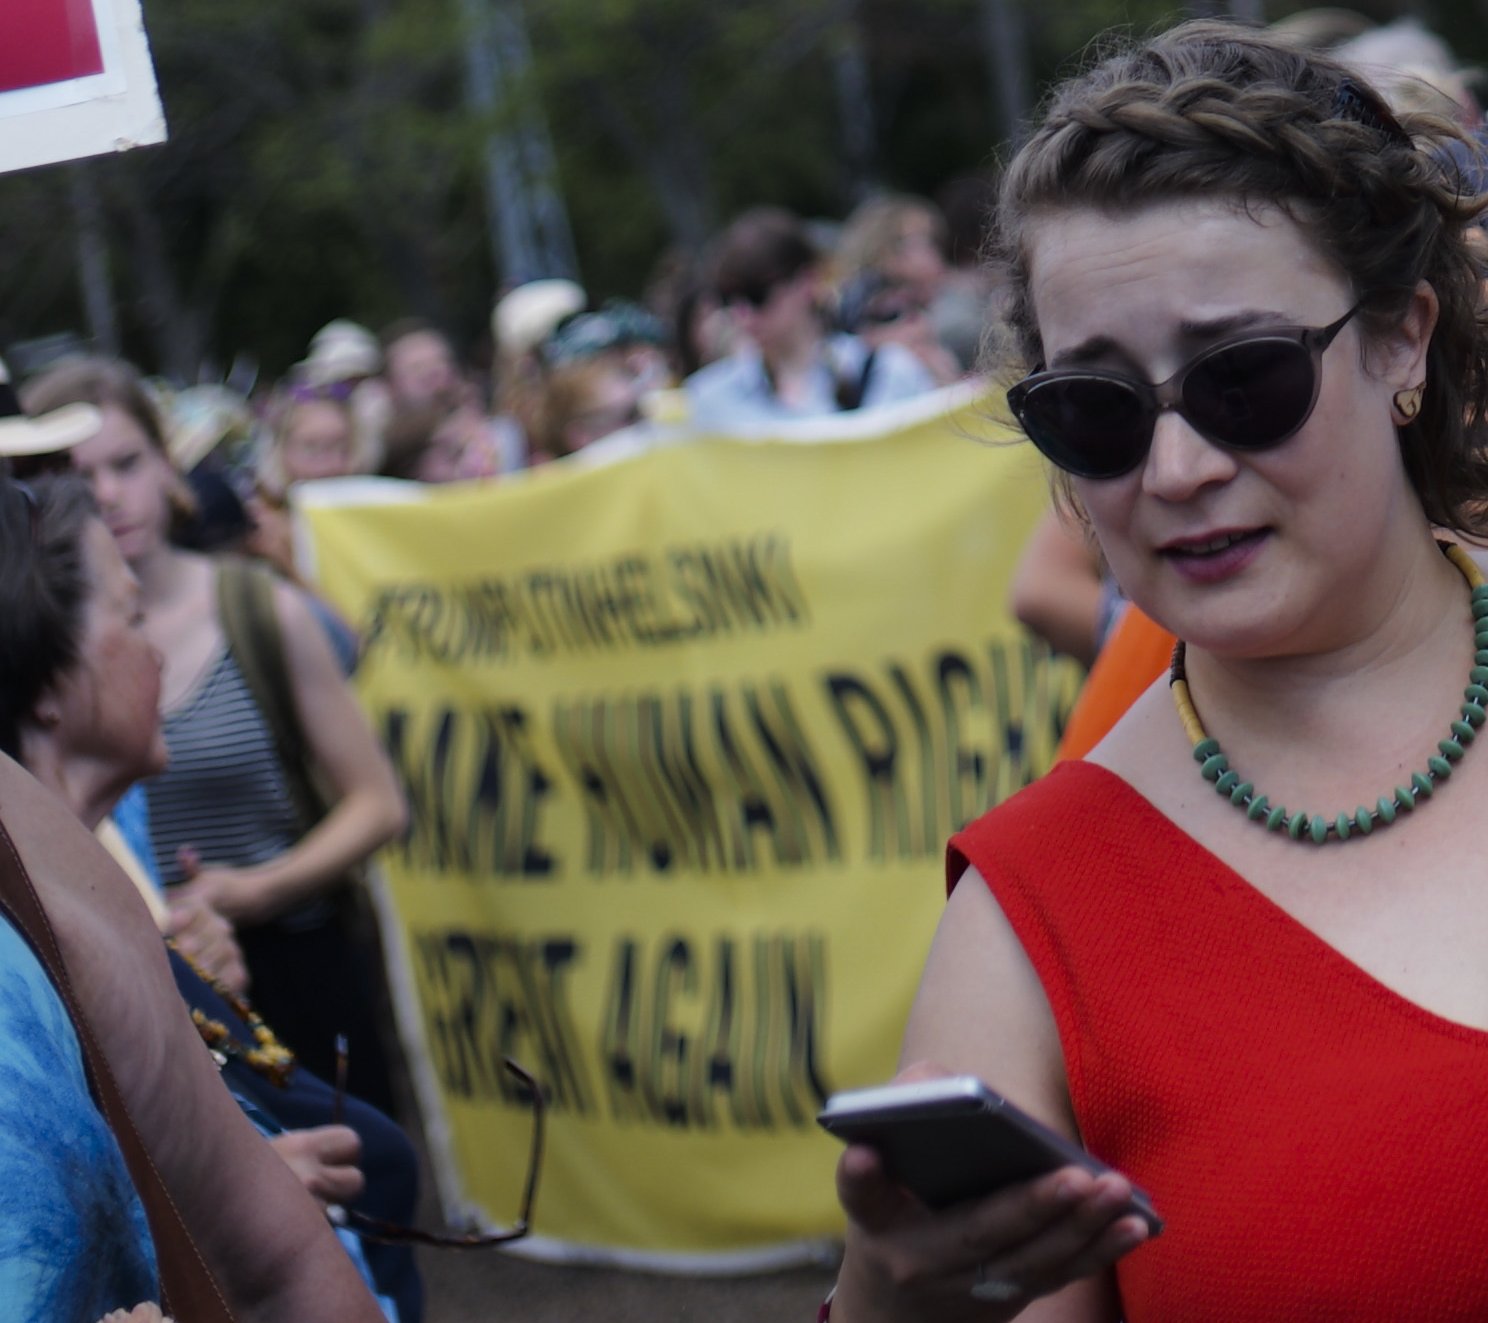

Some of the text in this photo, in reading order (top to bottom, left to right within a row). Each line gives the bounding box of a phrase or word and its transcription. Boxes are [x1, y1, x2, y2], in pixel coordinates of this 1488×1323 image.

[554, 673, 842, 876] HUMAN
[817, 633, 1067, 865] RIGH
[602, 923, 834, 1135] AGAIN
